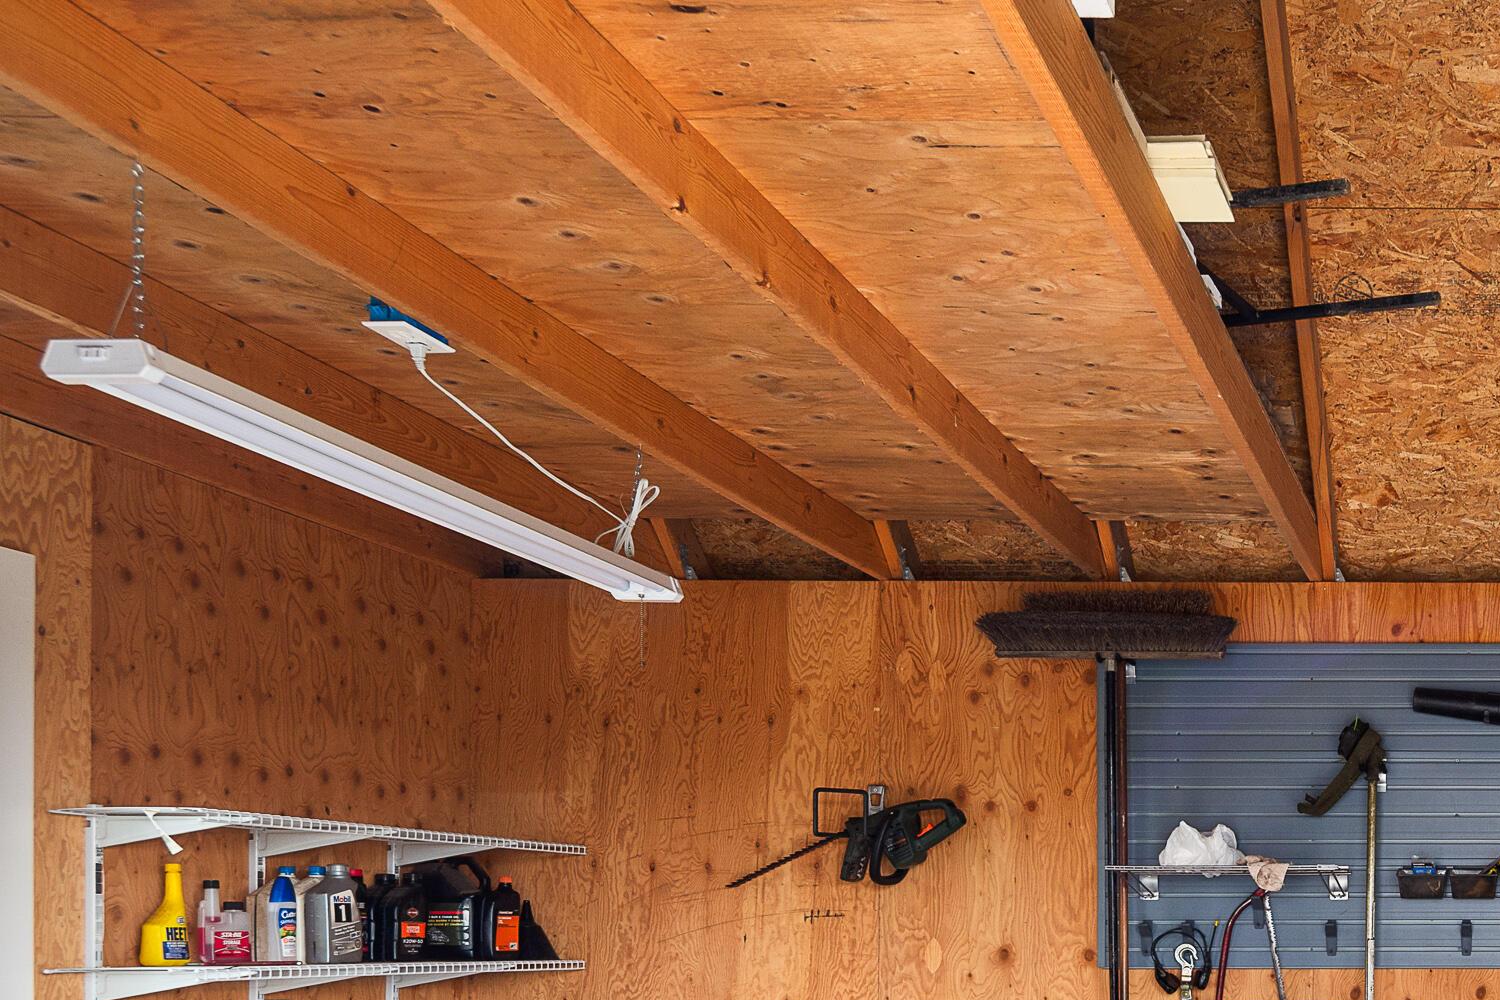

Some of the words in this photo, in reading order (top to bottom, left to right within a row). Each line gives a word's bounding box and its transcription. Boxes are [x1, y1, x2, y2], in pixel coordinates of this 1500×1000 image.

[333, 895, 352, 903] Mobil
[338, 904, 346, 922] 1
[166, 927, 187, 941] HEET
